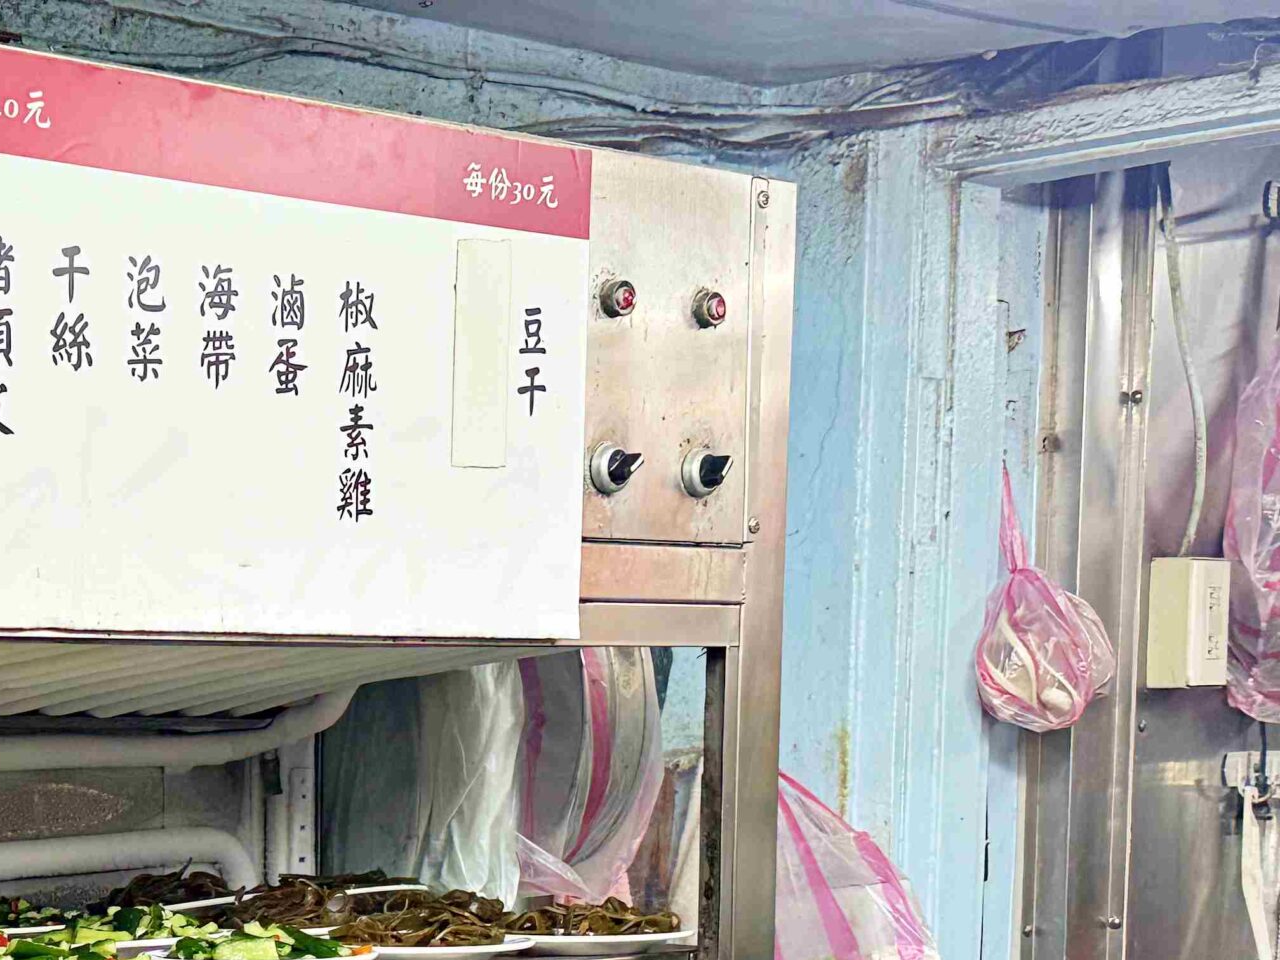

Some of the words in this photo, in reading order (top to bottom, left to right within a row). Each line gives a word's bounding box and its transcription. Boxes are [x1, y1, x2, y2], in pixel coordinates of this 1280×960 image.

[463, 162, 558, 209] 每份30元
[50, 245, 94, 372] 干絲
[127, 254, 167, 383] 泡菜
[198, 263, 239, 390] 海帶
[269, 273, 309, 397] 滷蛋
[517, 307, 548, 417] 豆干
[336, 280, 379, 524] 椒麻素雞
